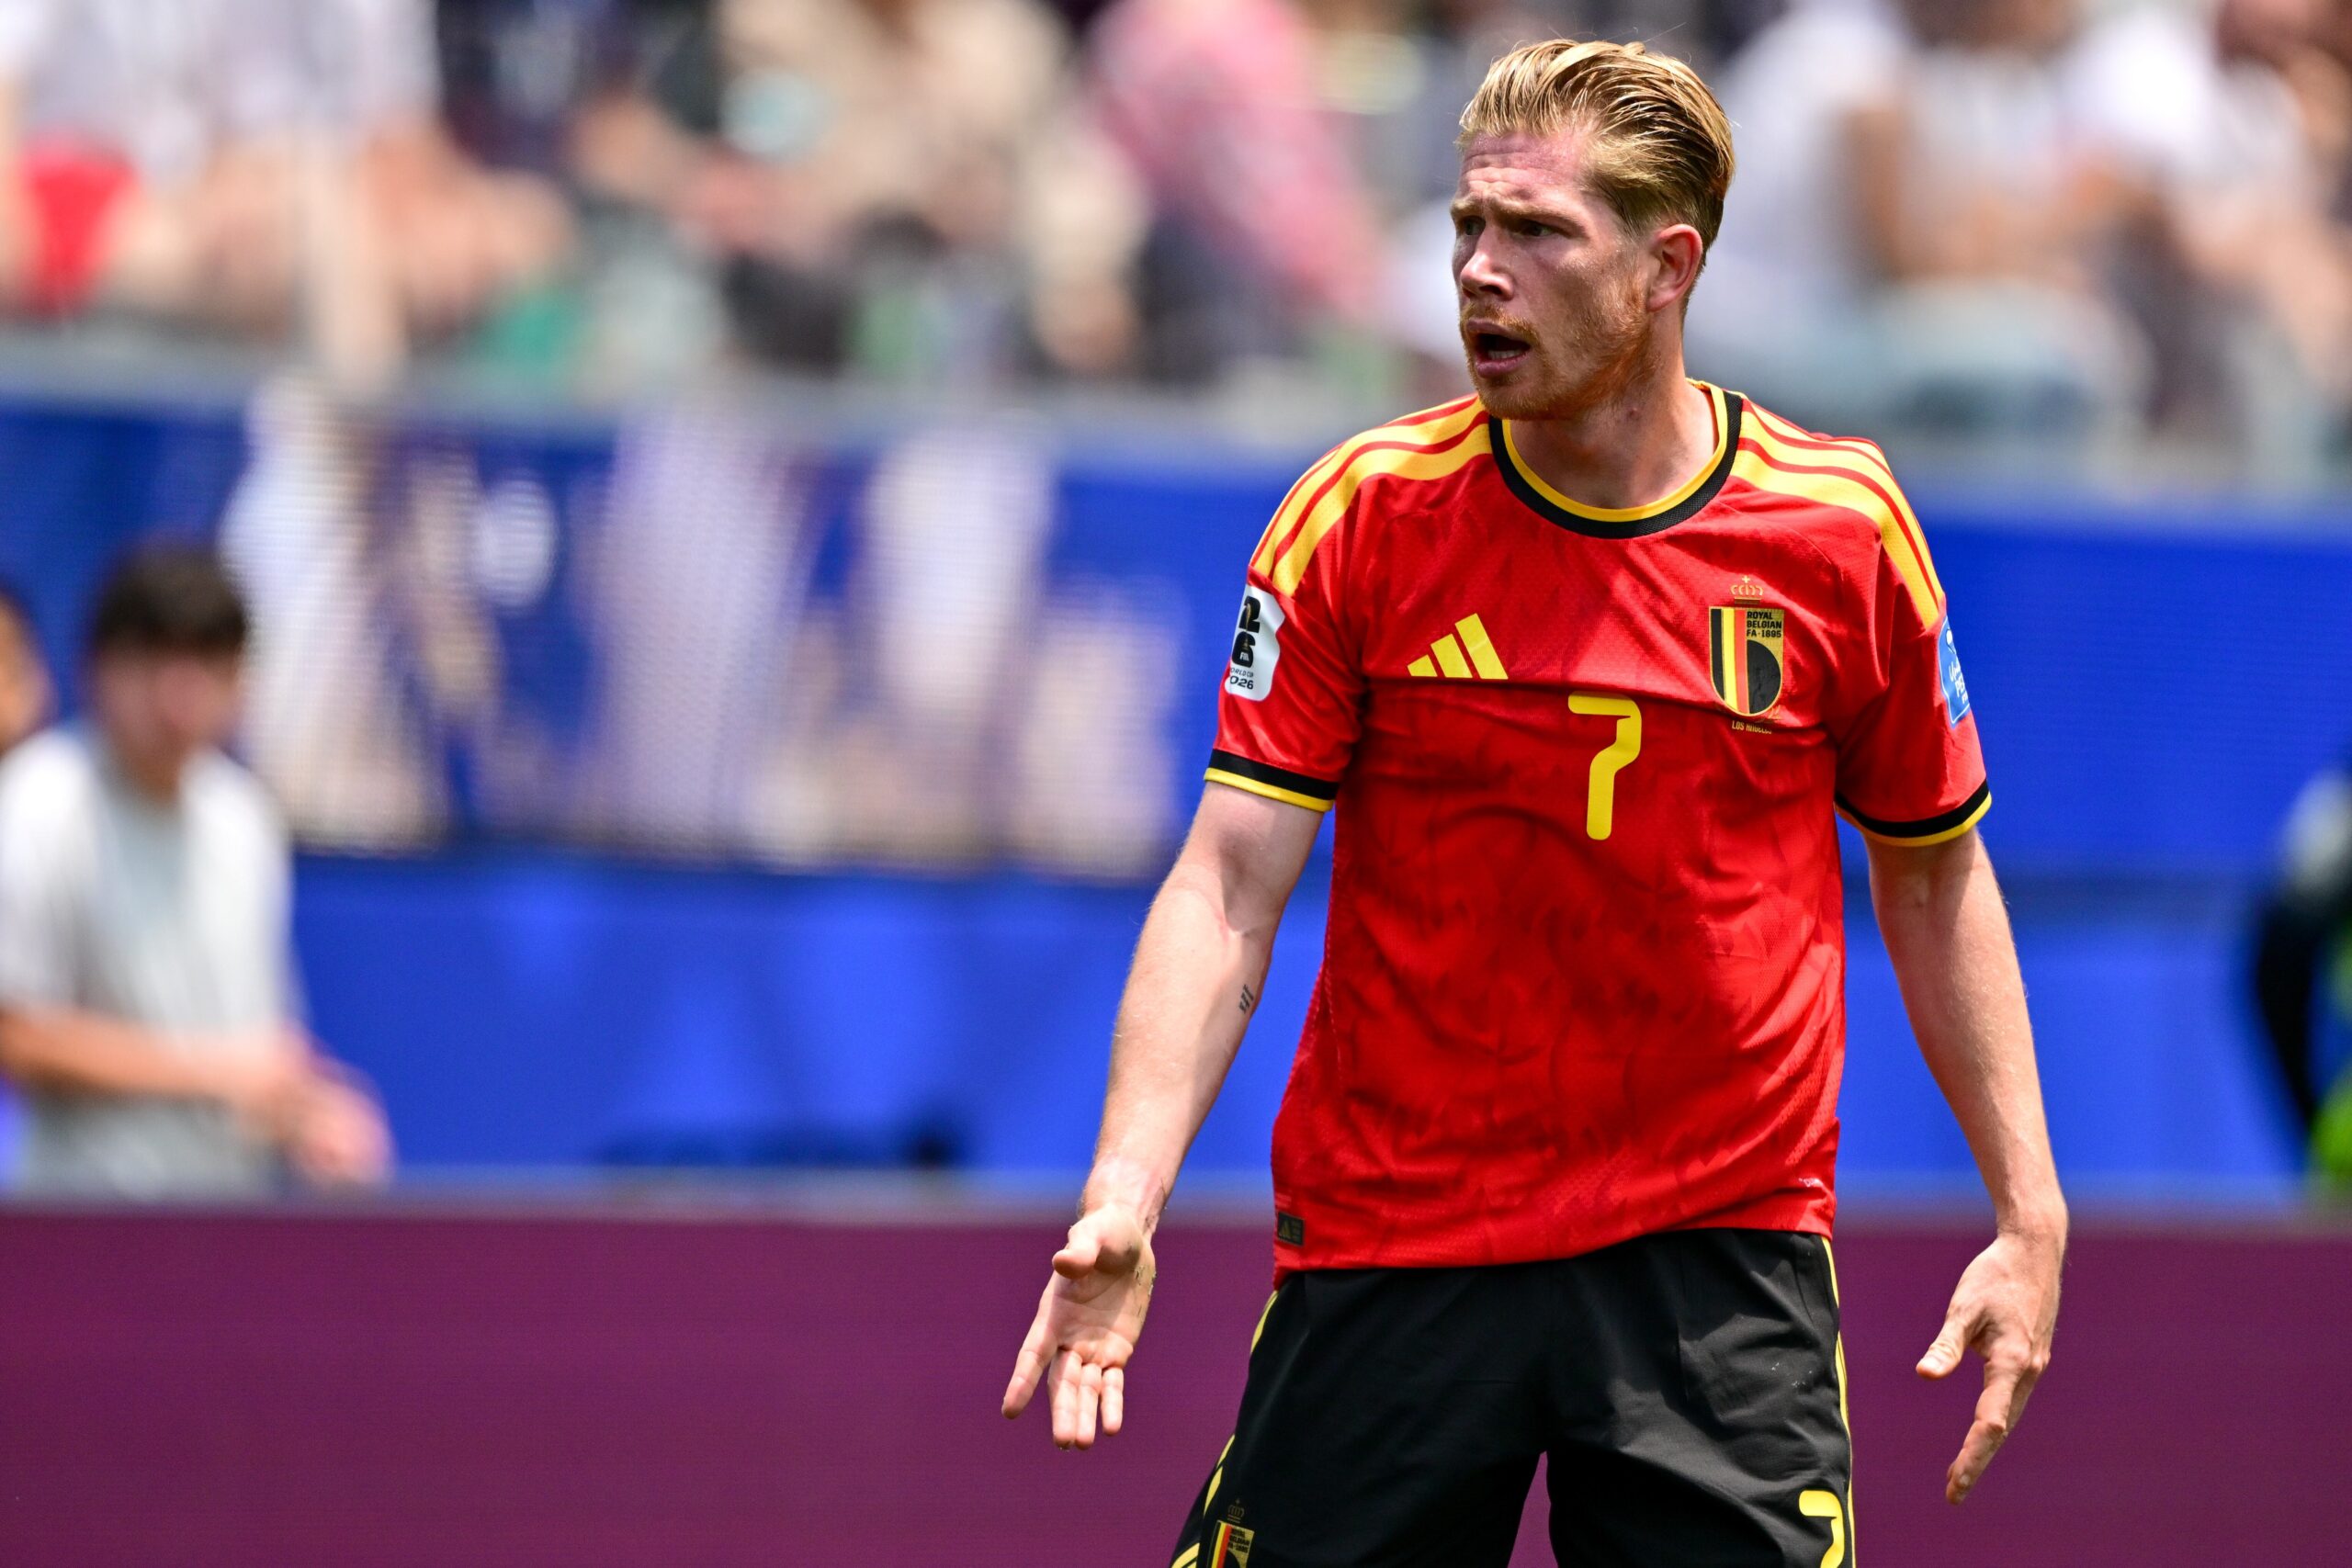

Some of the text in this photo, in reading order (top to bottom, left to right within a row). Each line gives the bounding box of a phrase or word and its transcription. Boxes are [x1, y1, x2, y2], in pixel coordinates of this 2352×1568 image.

[1747, 611, 1773, 620] ROYAL
[1747, 620, 1782, 629] BELGIAN
[1747, 628, 1757, 637] FA
[1761, 629, 1781, 638] 1895
[1230, 667, 1247, 677] ORLD
[1567, 690, 1643, 841] 7
[1798, 1489, 1845, 1568] 7
